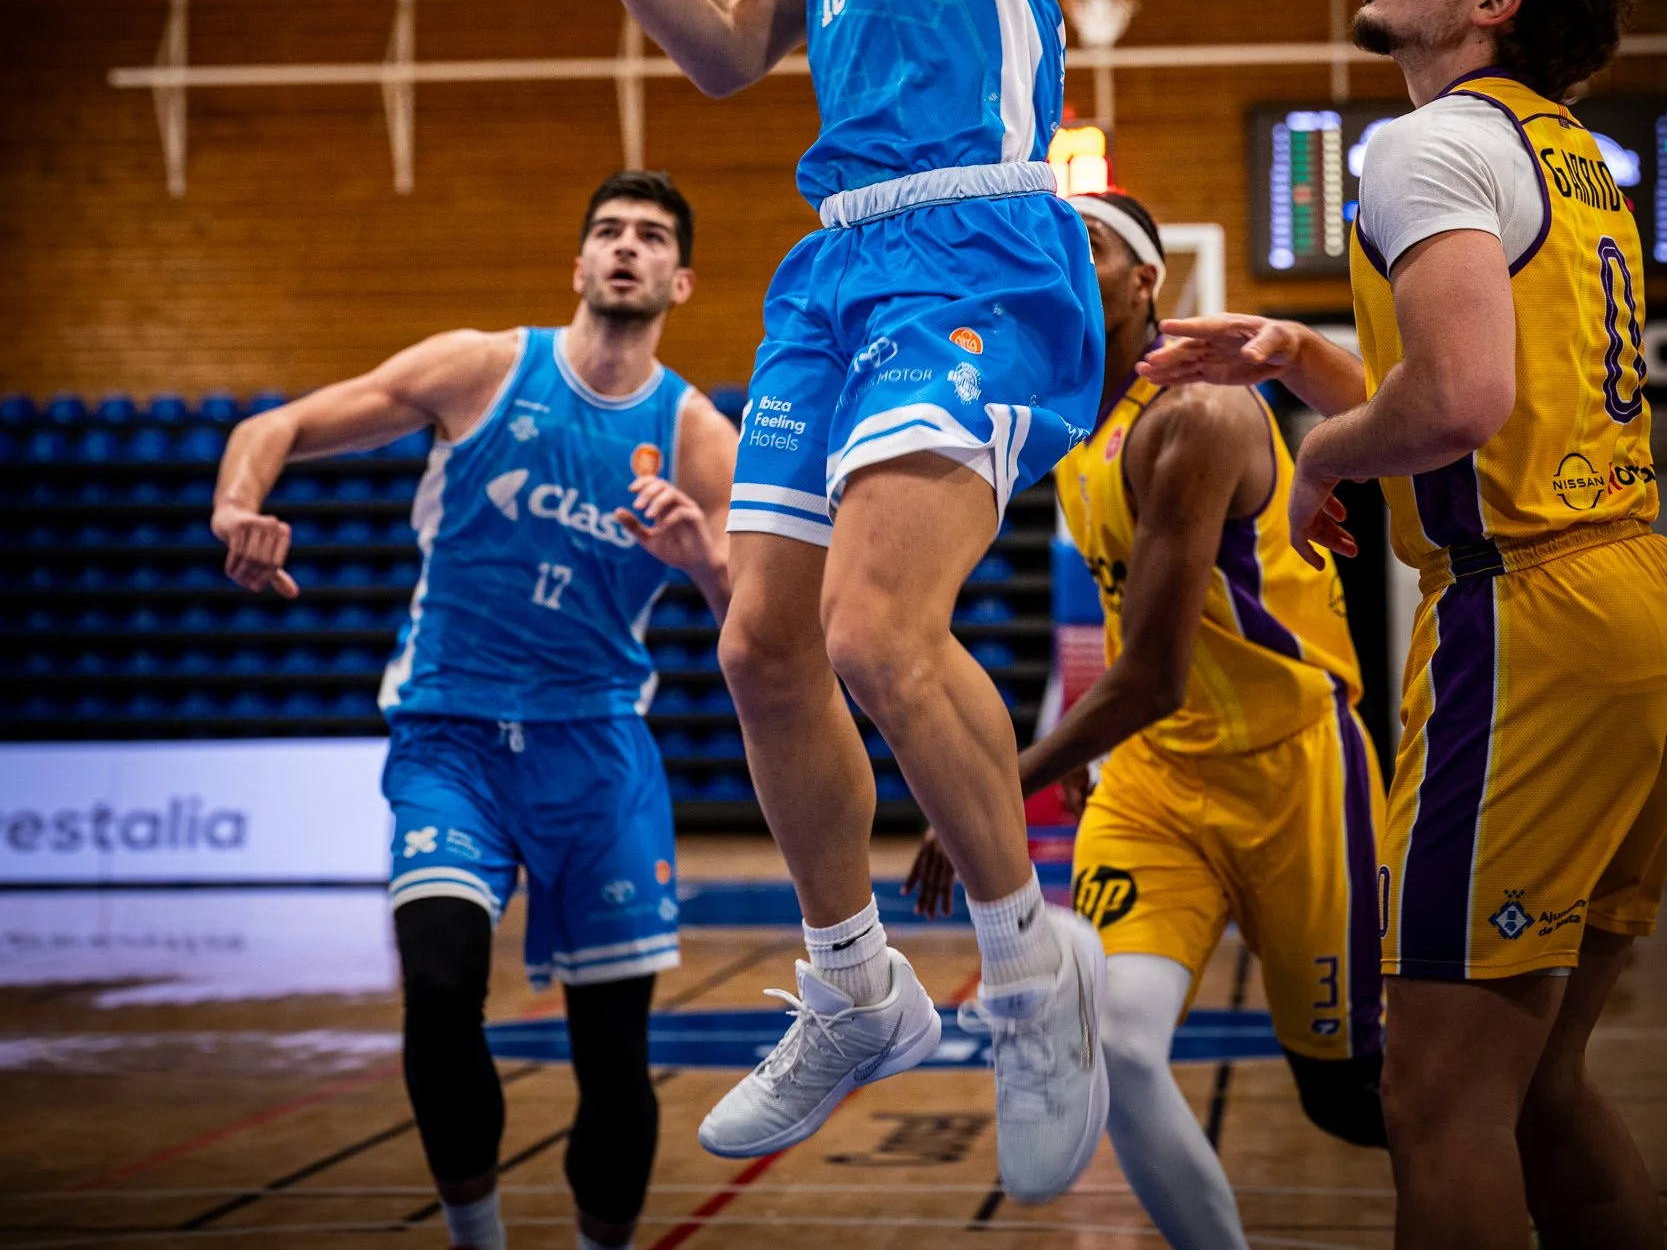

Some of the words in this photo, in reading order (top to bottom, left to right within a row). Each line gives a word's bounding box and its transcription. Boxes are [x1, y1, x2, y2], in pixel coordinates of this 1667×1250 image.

[1598, 236, 1647, 424] 0
[876, 367, 933, 386] MOTOR
[759, 395, 793, 413] Ibiza
[754, 412, 806, 435] Feeling
[749, 429, 799, 451] Hotels
[1552, 476, 1605, 491] NISSAN
[531, 562, 573, 611] 17
[0, 796, 248, 854] estalia
